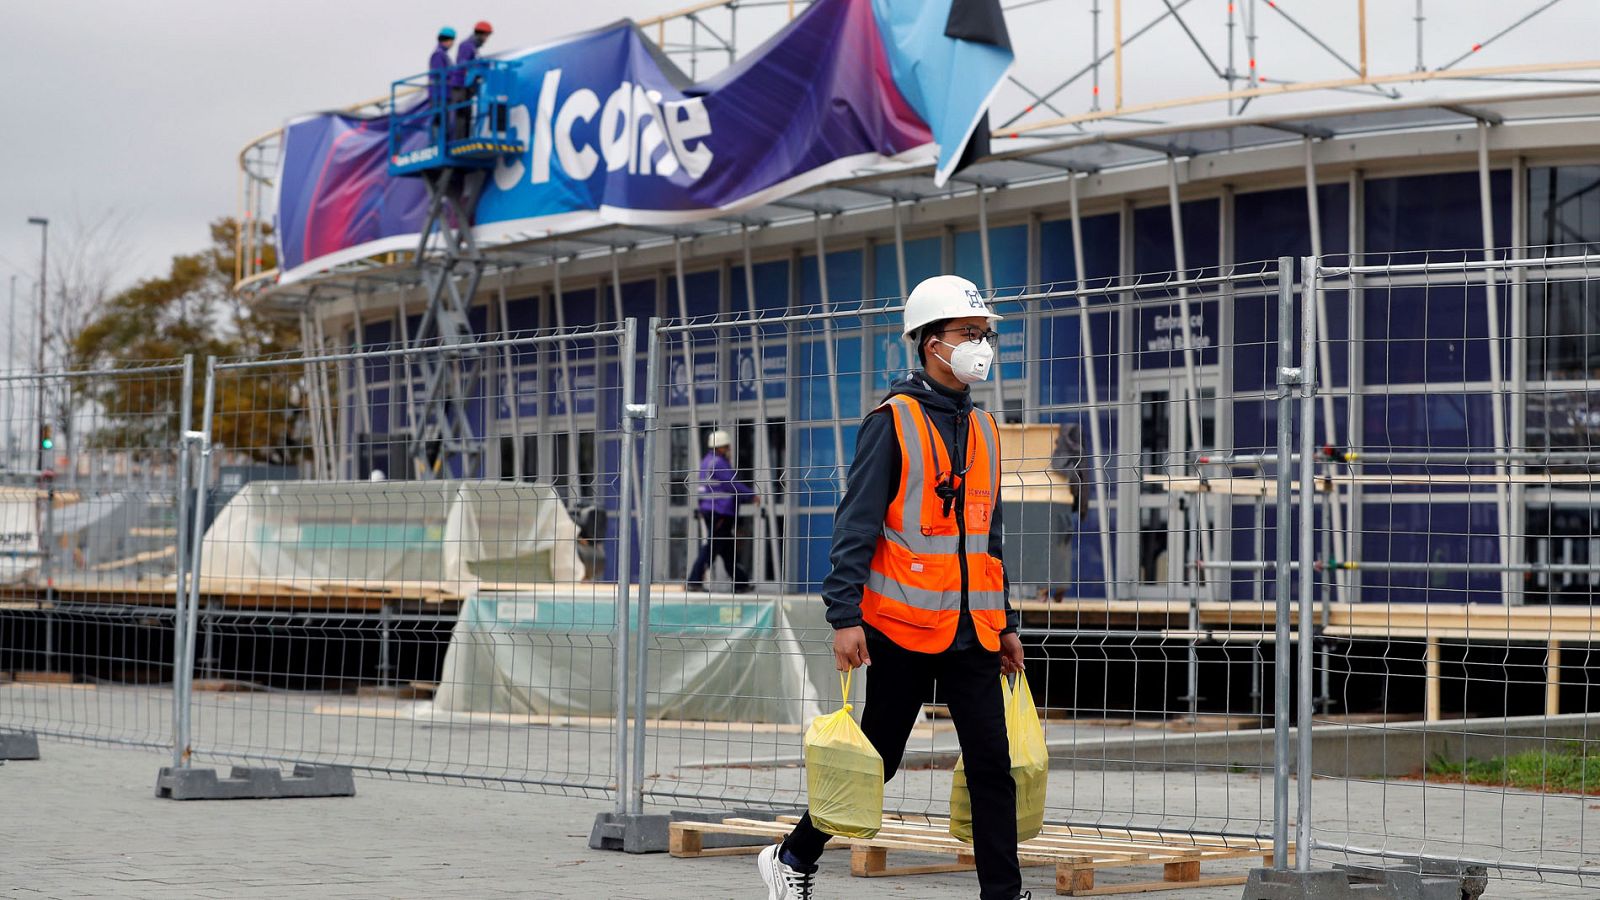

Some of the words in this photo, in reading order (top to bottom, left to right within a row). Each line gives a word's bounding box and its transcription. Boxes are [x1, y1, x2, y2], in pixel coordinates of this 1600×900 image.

[480, 68, 714, 190] elcome
[1154, 315, 1204, 331] Entrace
[1173, 333, 1211, 352] Bdge
